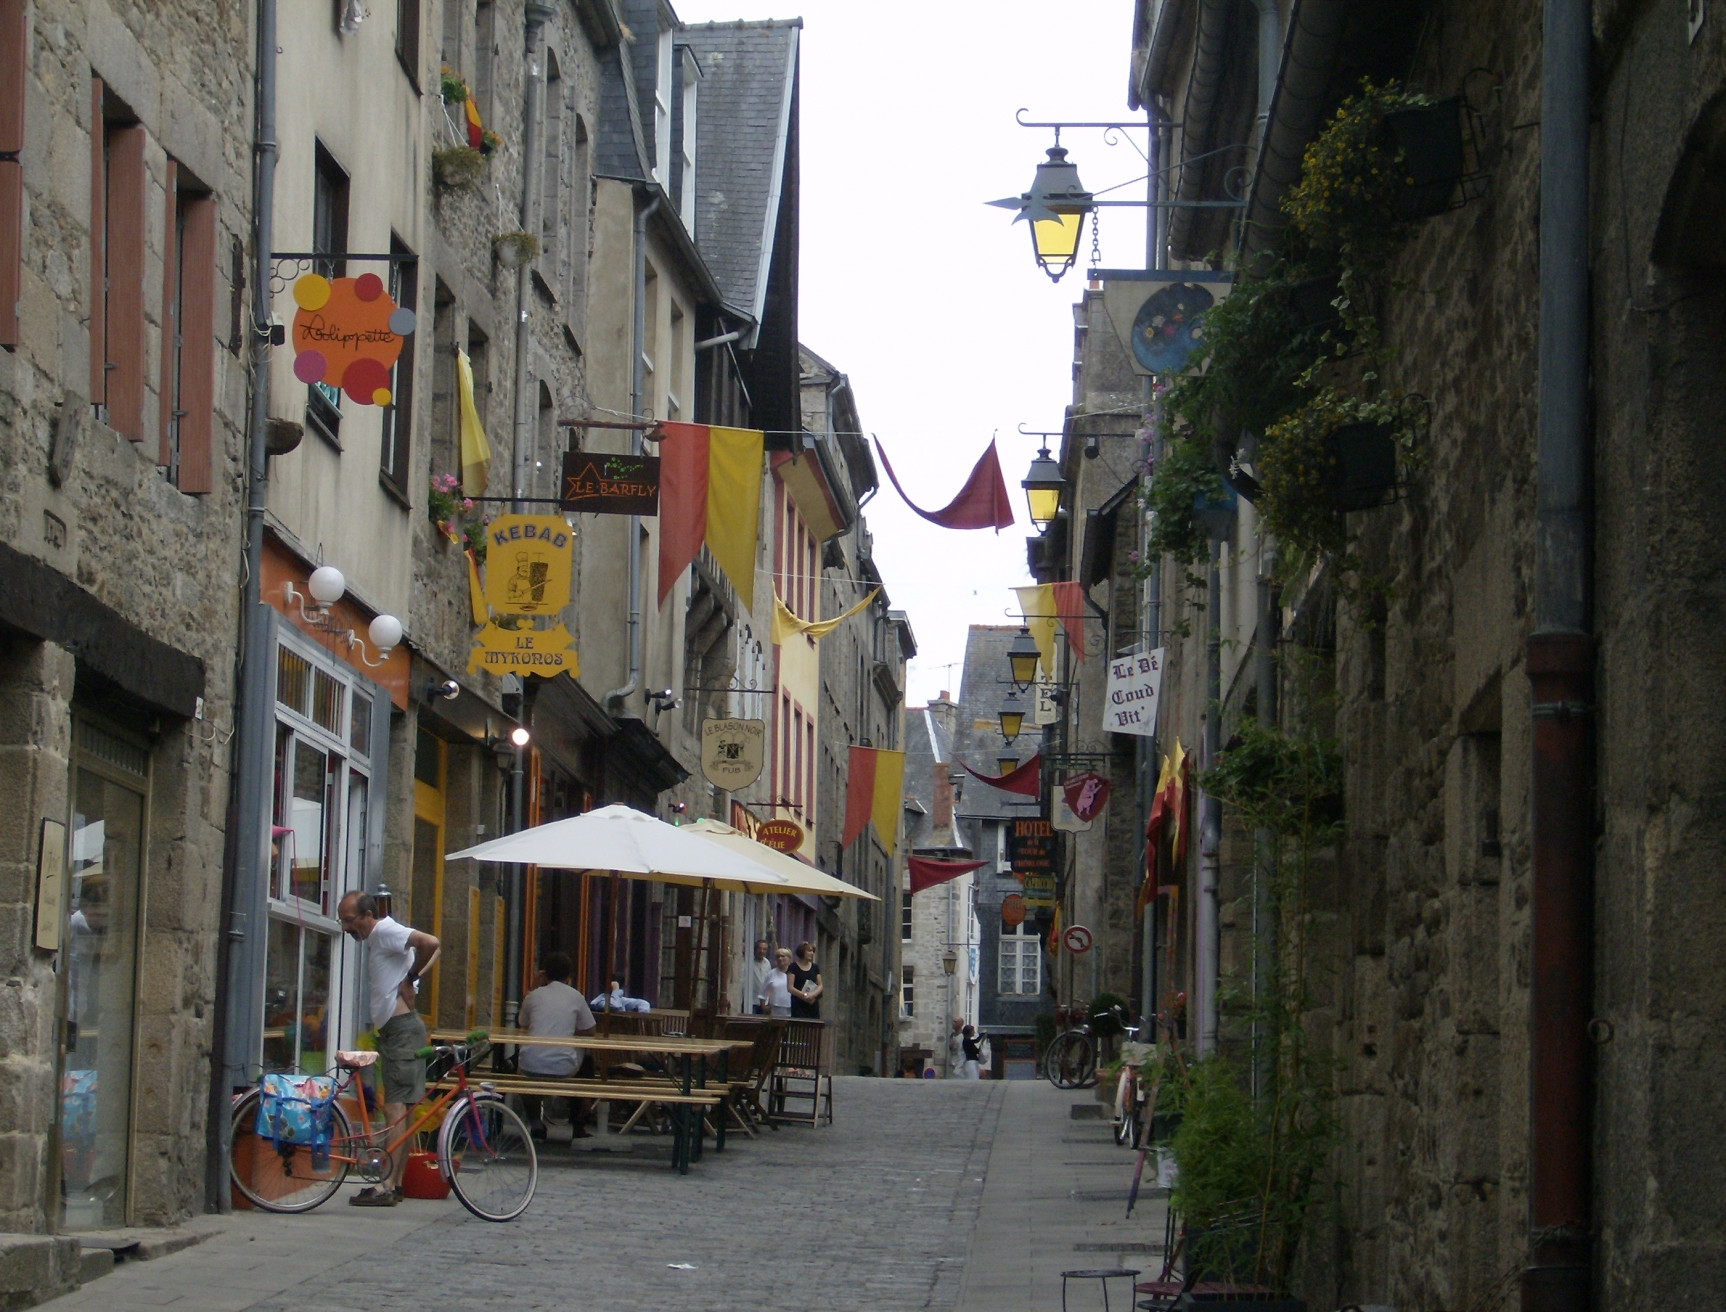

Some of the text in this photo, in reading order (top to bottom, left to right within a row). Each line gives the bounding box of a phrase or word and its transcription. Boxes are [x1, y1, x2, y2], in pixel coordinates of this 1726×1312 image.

[576, 482, 657, 497] LE BARFLY
[493, 524, 568, 549] KEBAB
[516, 636, 534, 649] LE
[485, 652, 563, 666] MYKONOS
[1113, 655, 1158, 680] Le Dé
[1112, 683, 1155, 705] Coud
[704, 721, 762, 737] LE BLASON NOIR
[722, 766, 741, 774] PUB
[762, 826, 798, 838] ATELIER
[1015, 820, 1053, 837] HOTEL
